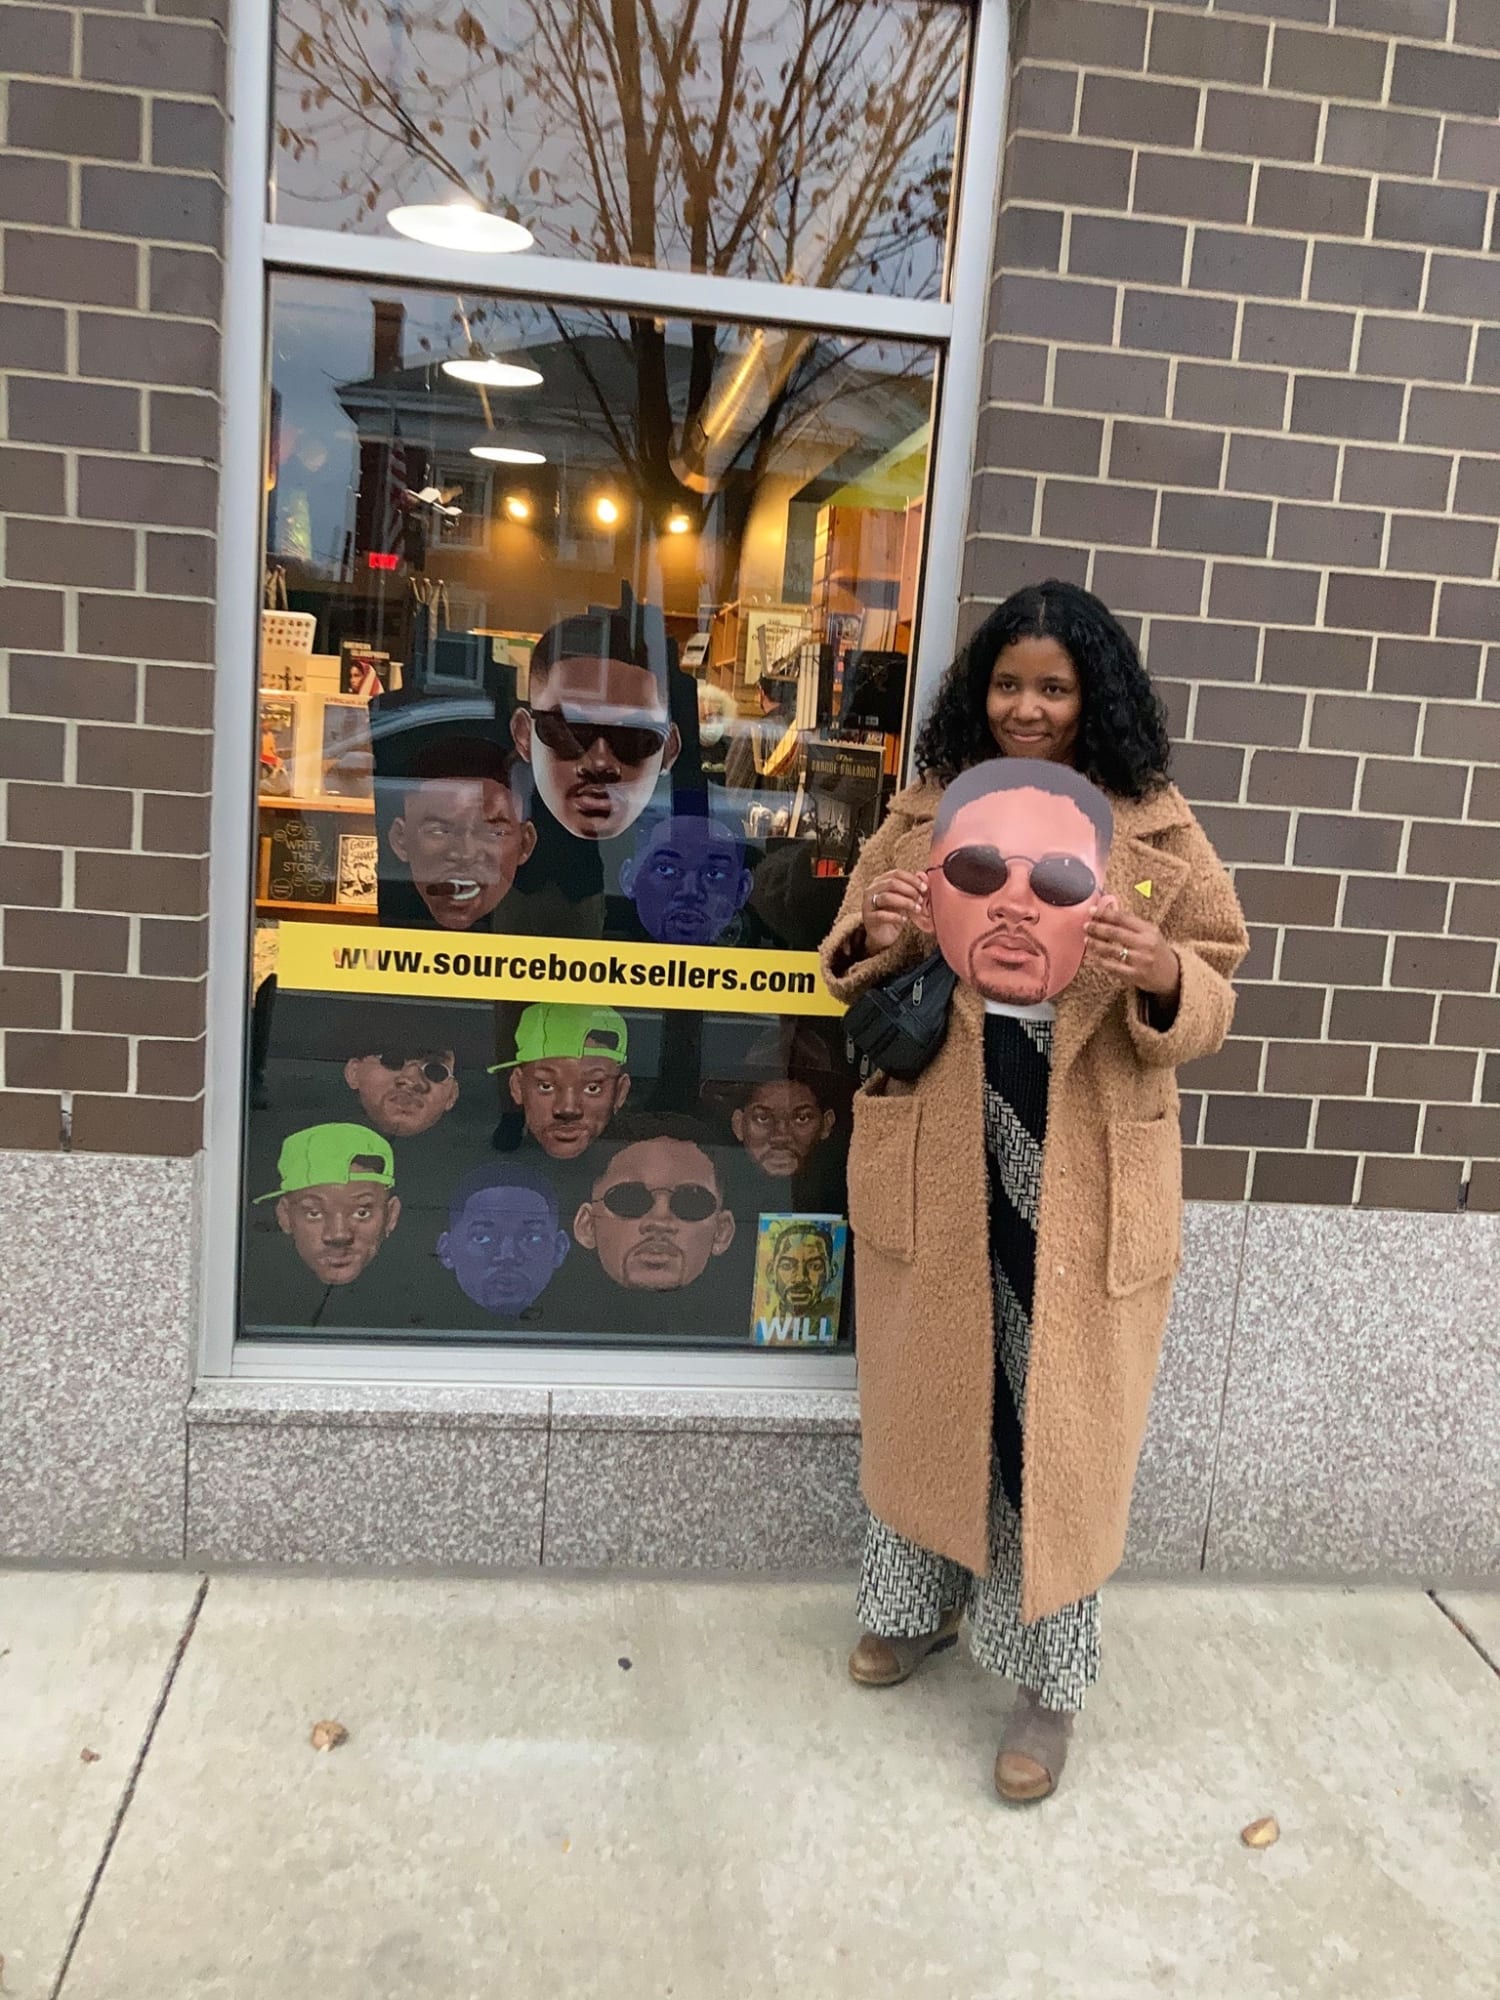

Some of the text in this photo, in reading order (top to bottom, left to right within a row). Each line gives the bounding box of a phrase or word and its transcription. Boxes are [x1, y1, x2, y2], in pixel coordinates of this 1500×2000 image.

[285, 839, 322, 852] WRITE
[291, 851, 315, 863] THE
[282, 861, 321, 873] STORY
[333, 947, 816, 994] www.sourcebooksellers.com
[757, 1315, 834, 1343] WILL
